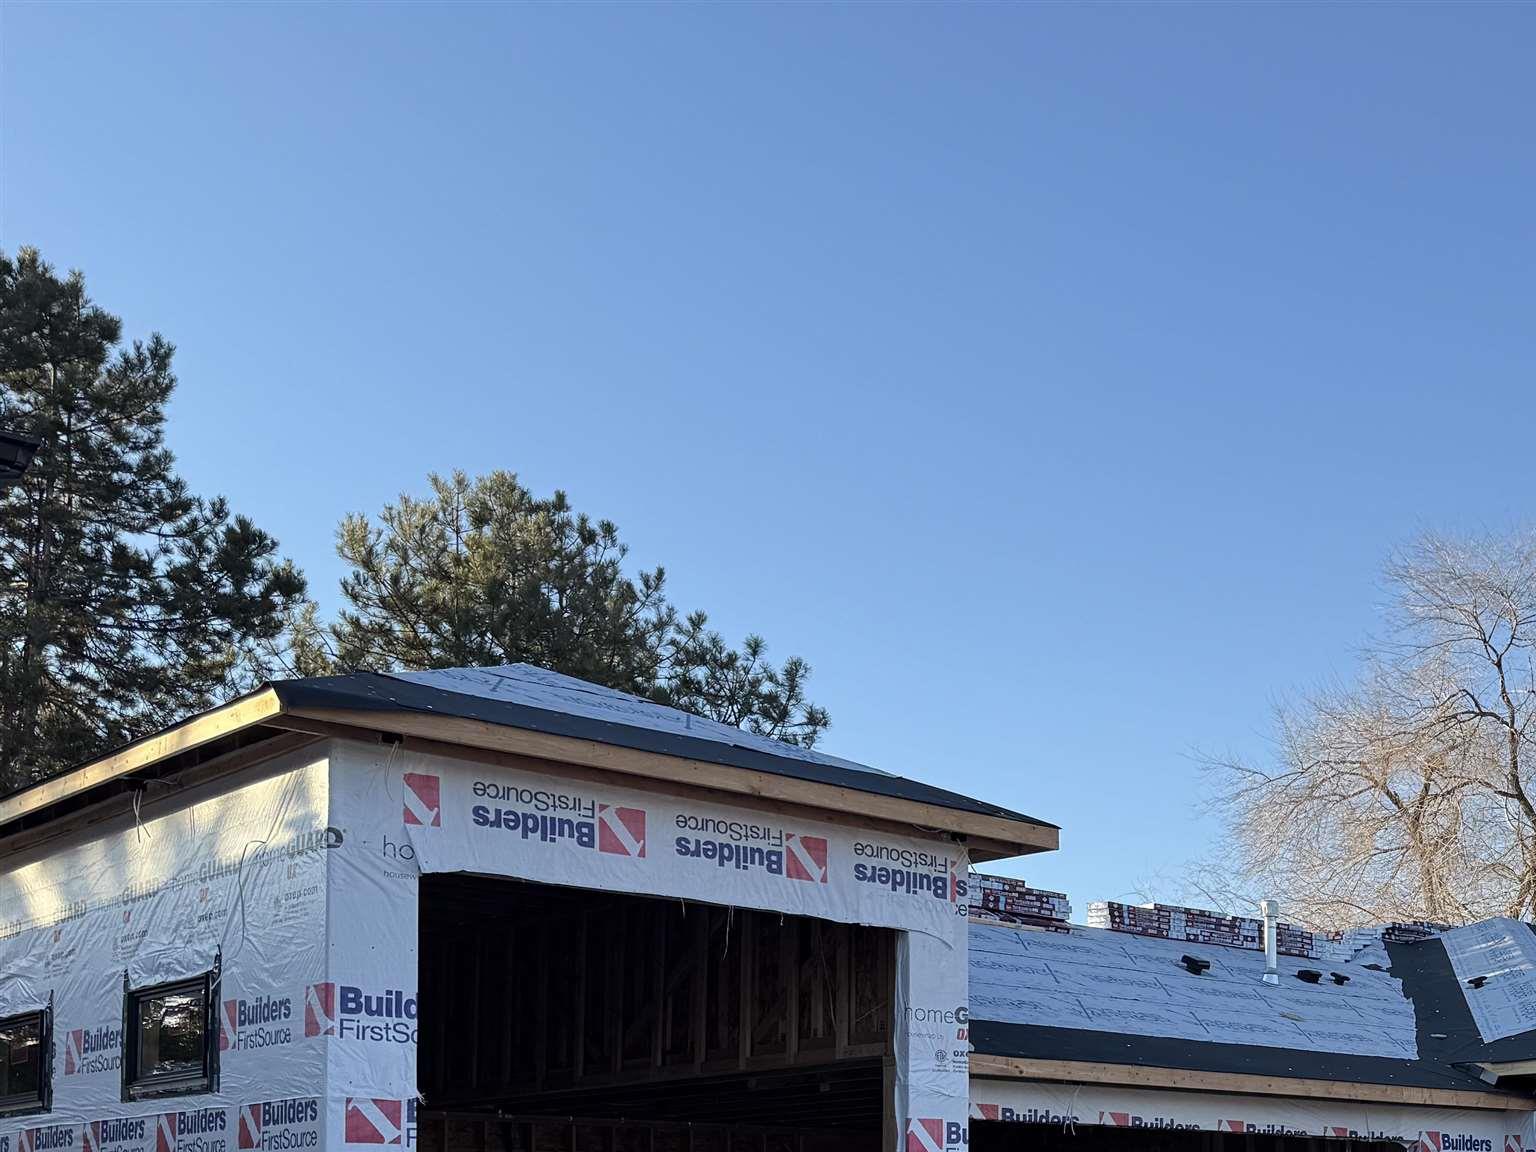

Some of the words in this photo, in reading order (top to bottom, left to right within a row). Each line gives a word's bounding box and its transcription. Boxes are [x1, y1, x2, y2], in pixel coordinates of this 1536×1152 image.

[472, 780, 596, 818] FirstSource
[471, 805, 596, 849] Builders
[675, 814, 783, 848] FirstSource
[675, 836, 784, 876] Builders
[853, 842, 948, 874] FirstSource
[853, 863, 948, 900] Builders
[238, 997, 292, 1027] Builders
[177, 1107, 226, 1135] Builders
[262, 1099, 318, 1127] Builders
[34, 1127, 74, 1151] Builders
[100, 1117, 146, 1143] Builders
[1441, 1133, 1492, 1152] Builders
